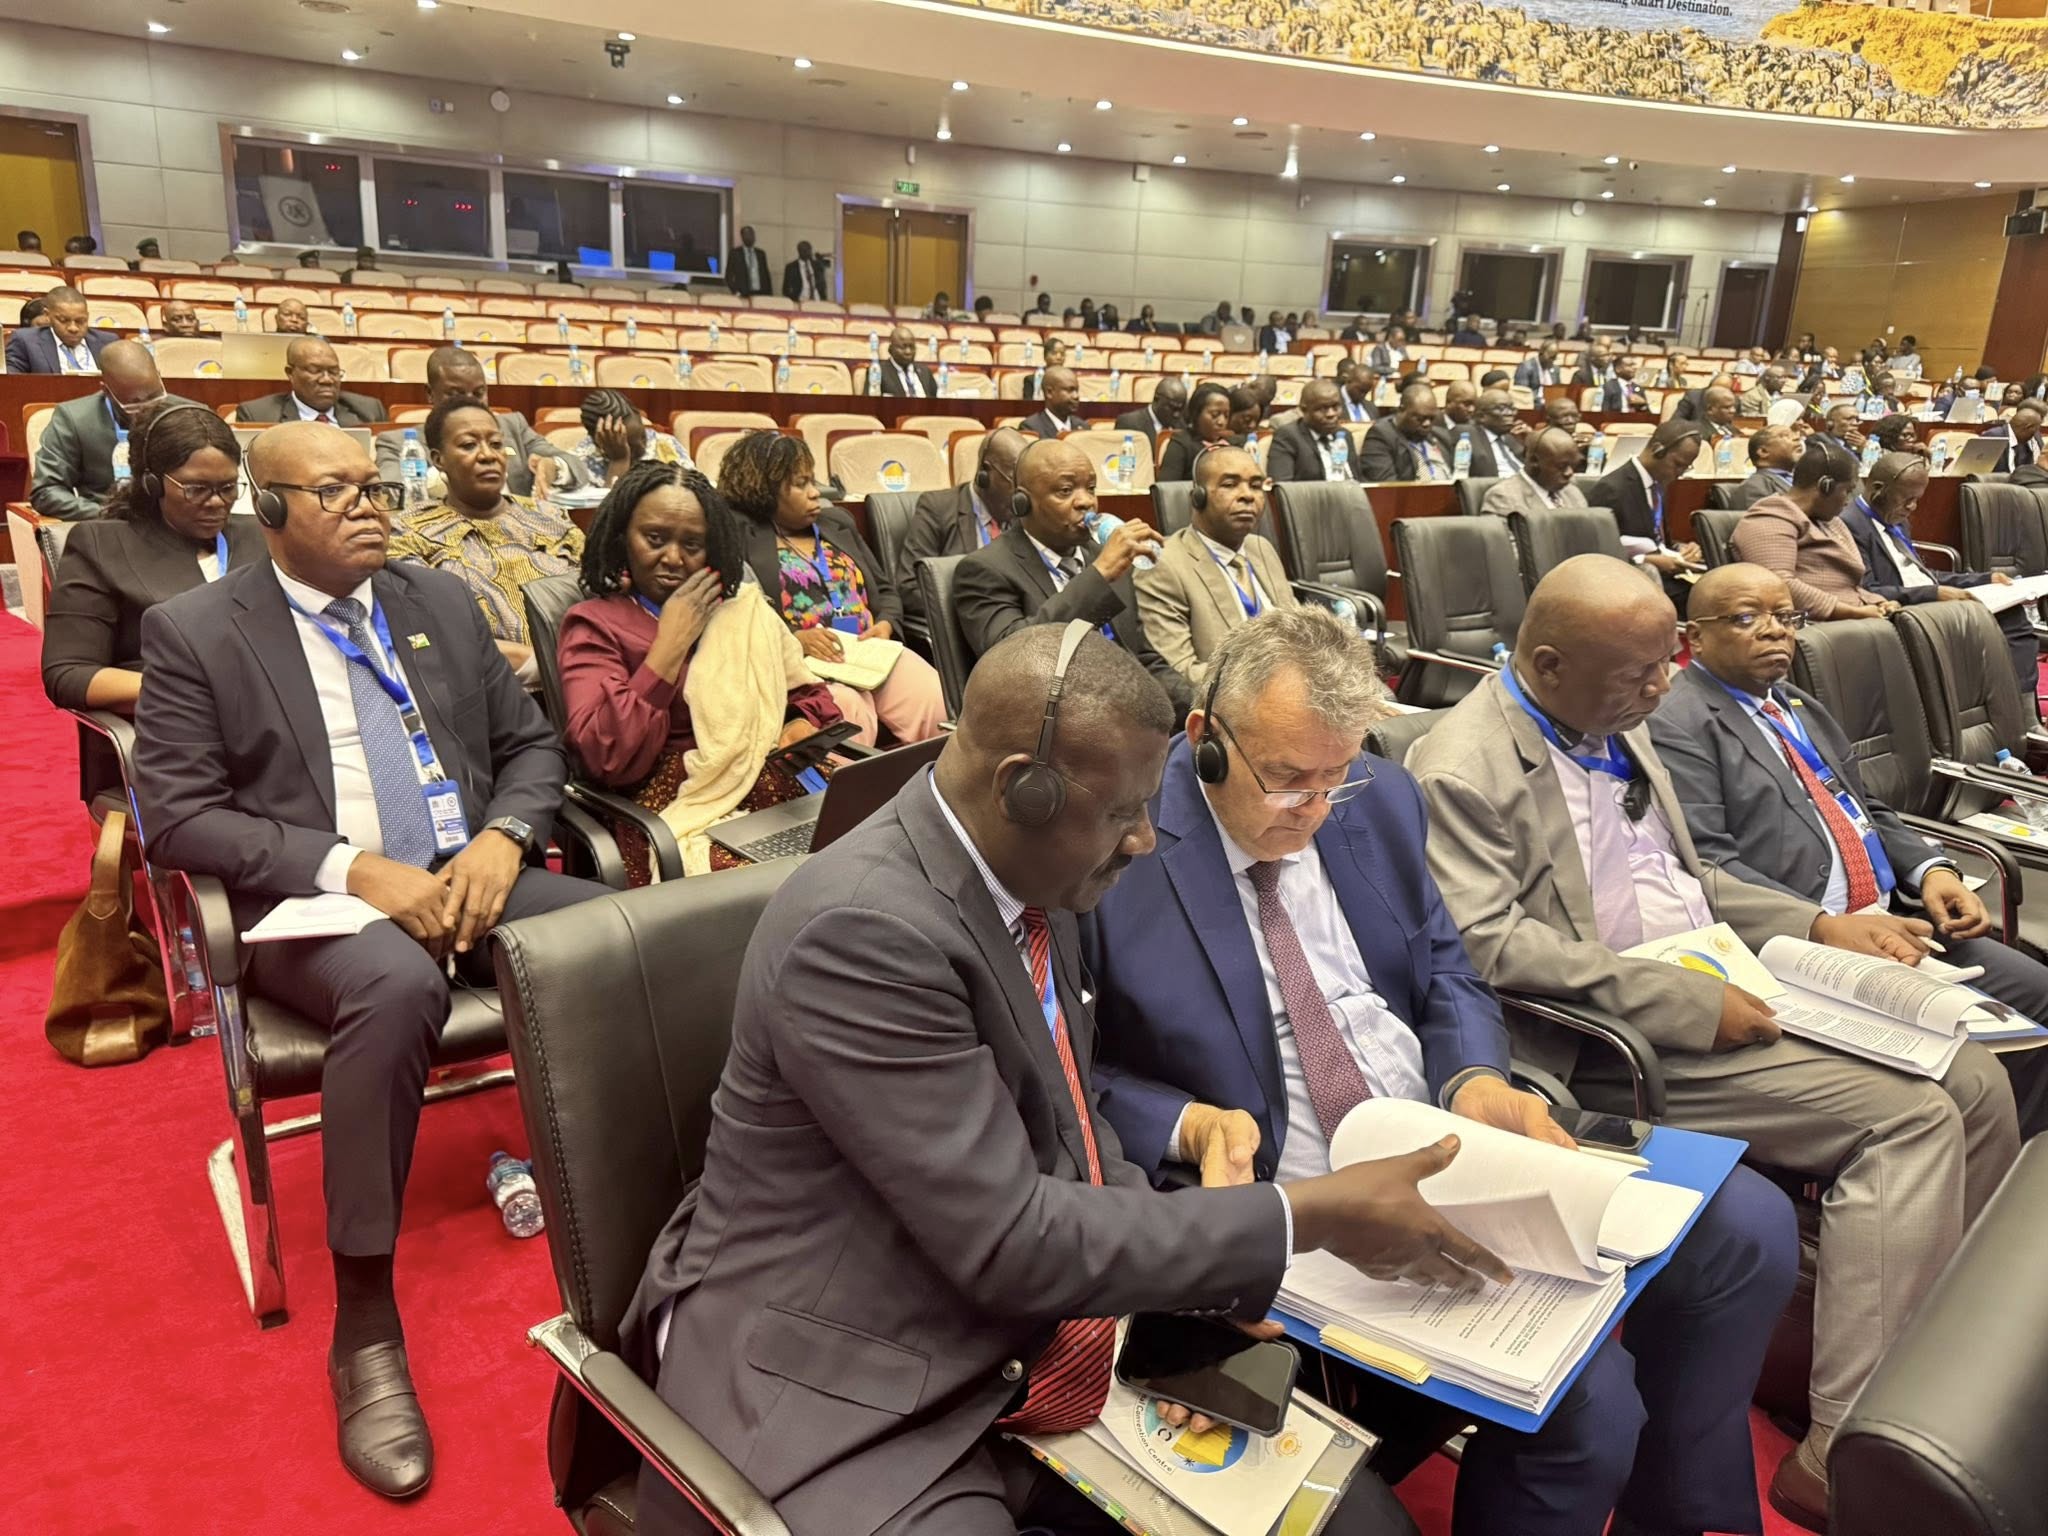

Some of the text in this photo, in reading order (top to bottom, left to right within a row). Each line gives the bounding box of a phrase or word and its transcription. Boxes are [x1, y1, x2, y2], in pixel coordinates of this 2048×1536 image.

[1667, 0, 1733, 16] Destination.
[1135, 1405, 1149, 1448] Convention
[1148, 1448, 1173, 1472] Centre
